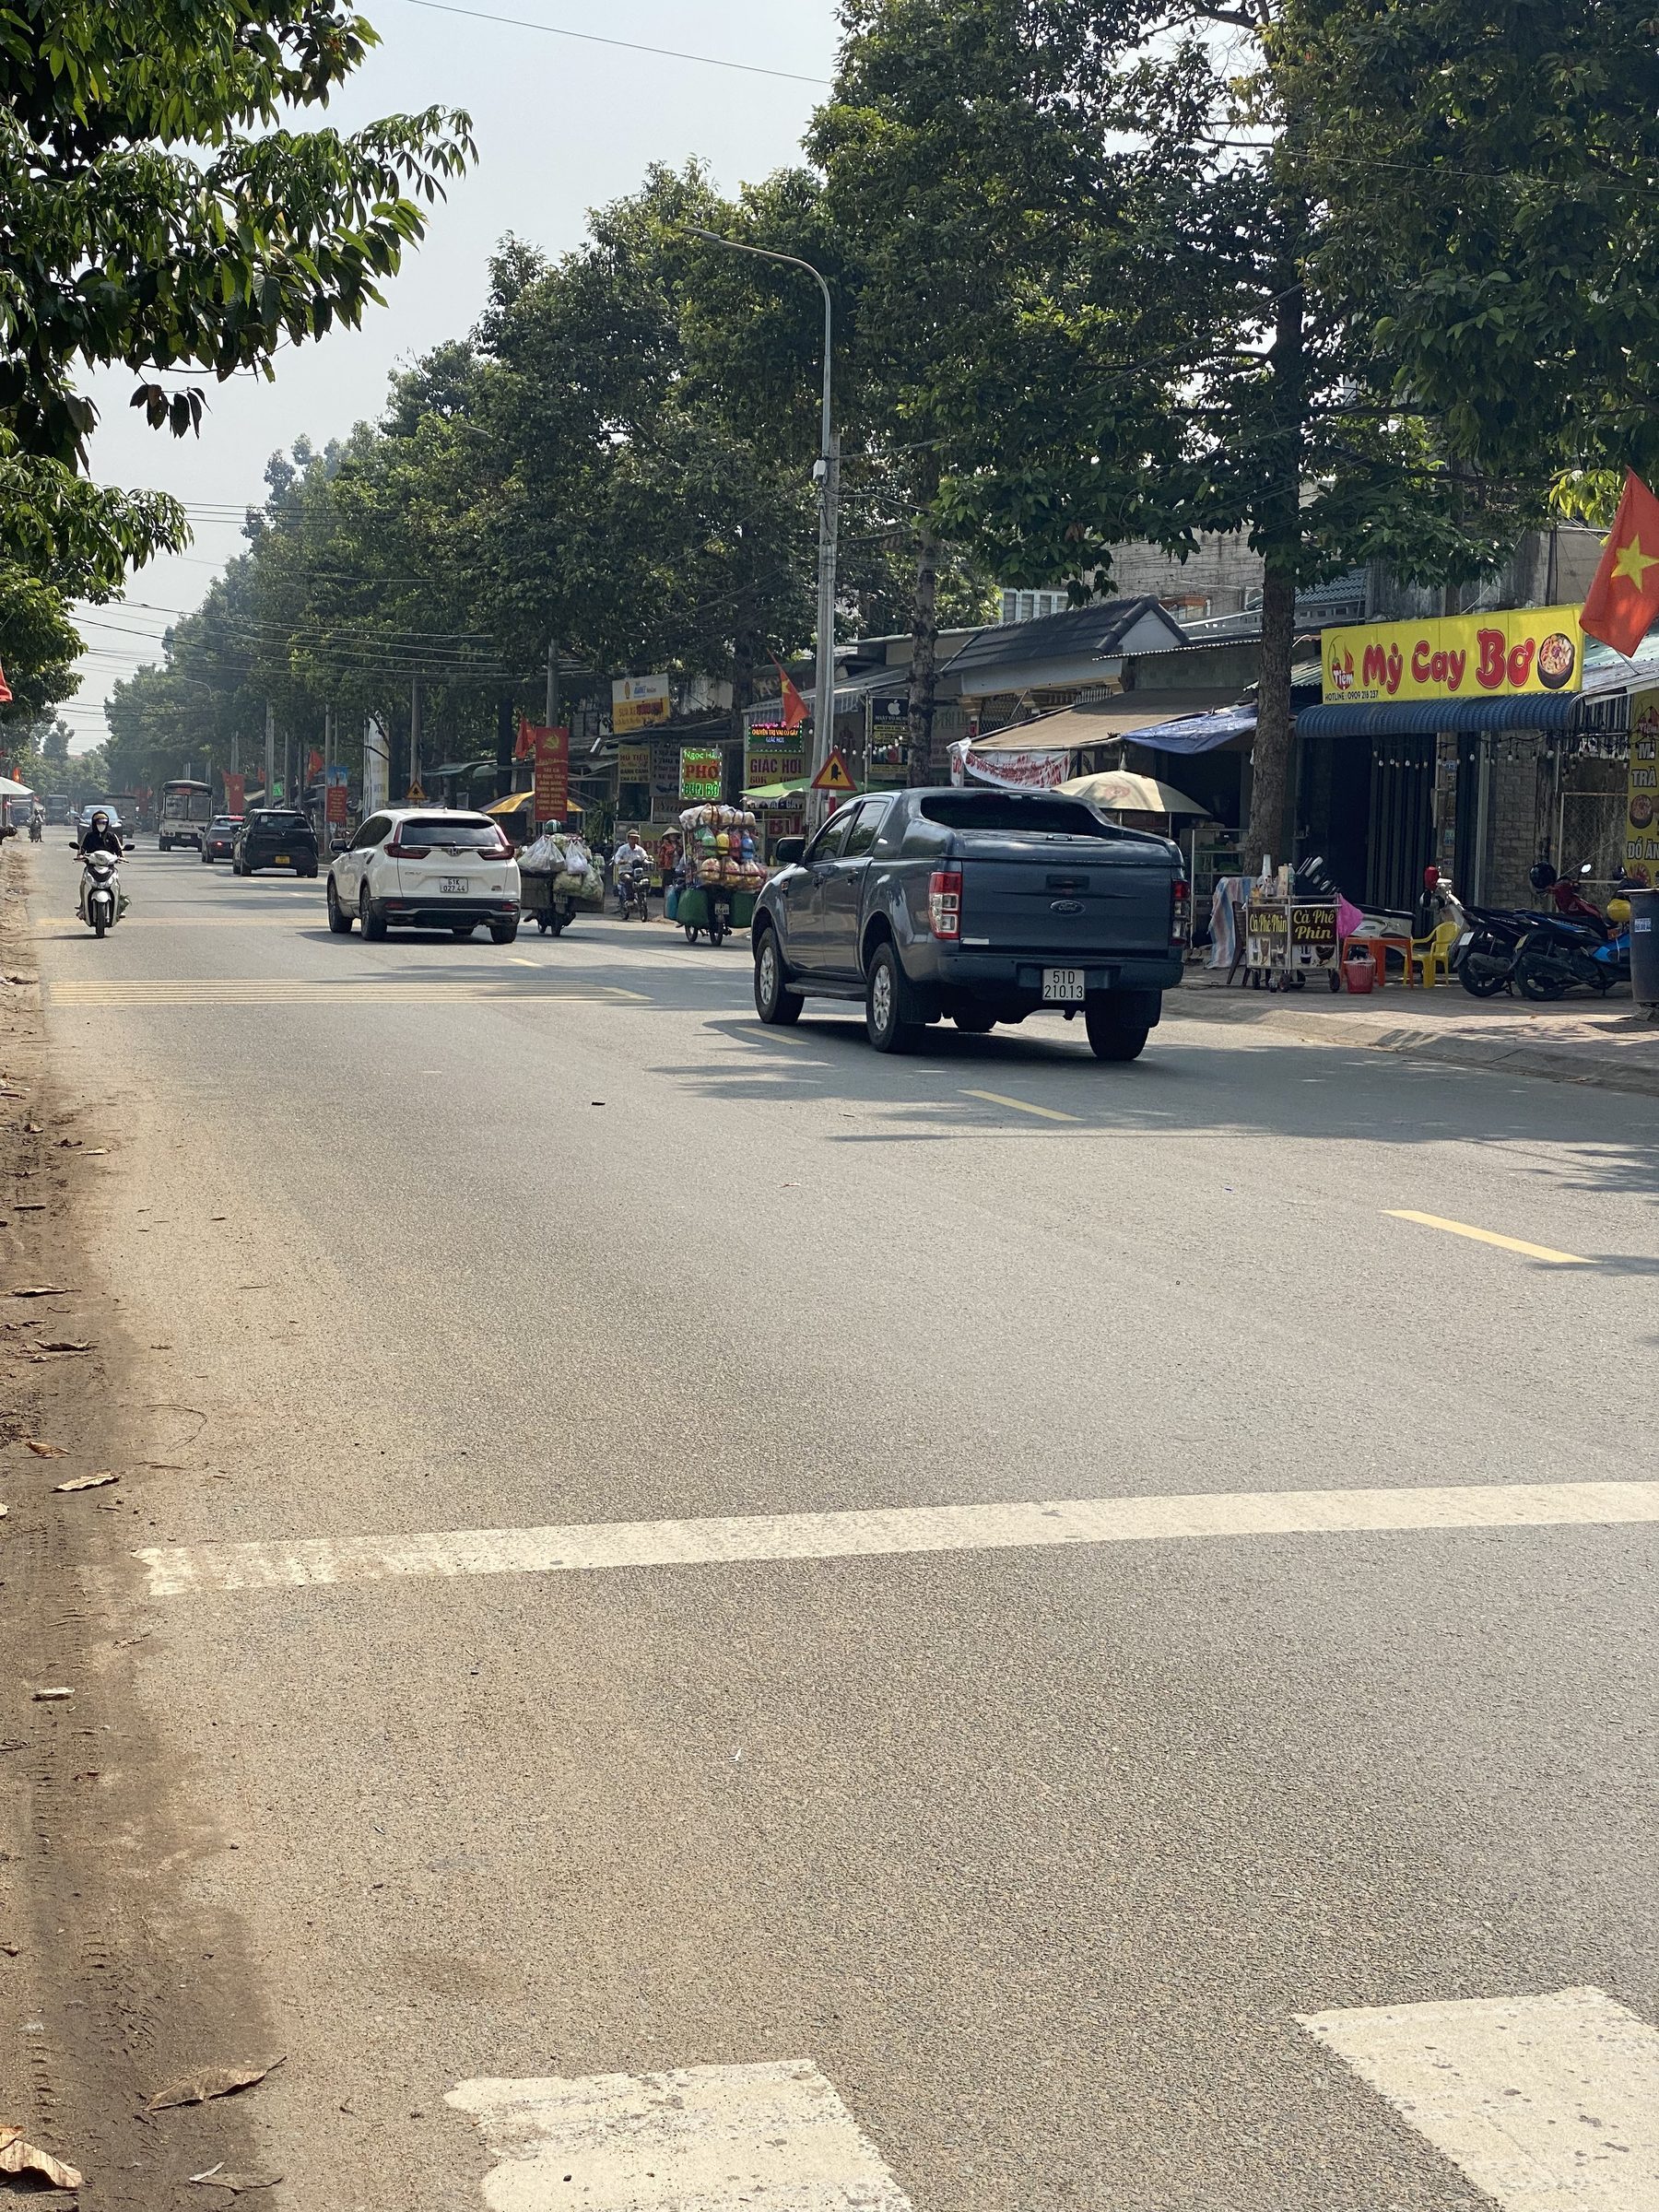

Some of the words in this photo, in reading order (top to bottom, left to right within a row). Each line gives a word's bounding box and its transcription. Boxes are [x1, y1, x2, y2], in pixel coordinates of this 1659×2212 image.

[1411, 640, 1466, 691] Cay
[1476, 629, 1535, 688] Bơ
[1333, 669, 1354, 689] Tiệm
[1347, 691, 1361, 700] 0909
[684, 749, 704, 759] Ngọc
[685, 759, 719, 779] PHỞ
[1631, 766, 1657, 787] TRÀ
[1057, 901, 1078, 912] Ford
[1250, 913, 1258, 933] Cà
[1259, 913, 1272, 933] Phê
[1272, 913, 1288, 933] Phin
[1293, 909, 1311, 924] Cà
[1312, 909, 1335, 924] Phê
[1294, 925, 1334, 939] Phin
[1053, 971, 1075, 984] 51D
[1044, 985, 1083, 999] 210.13
